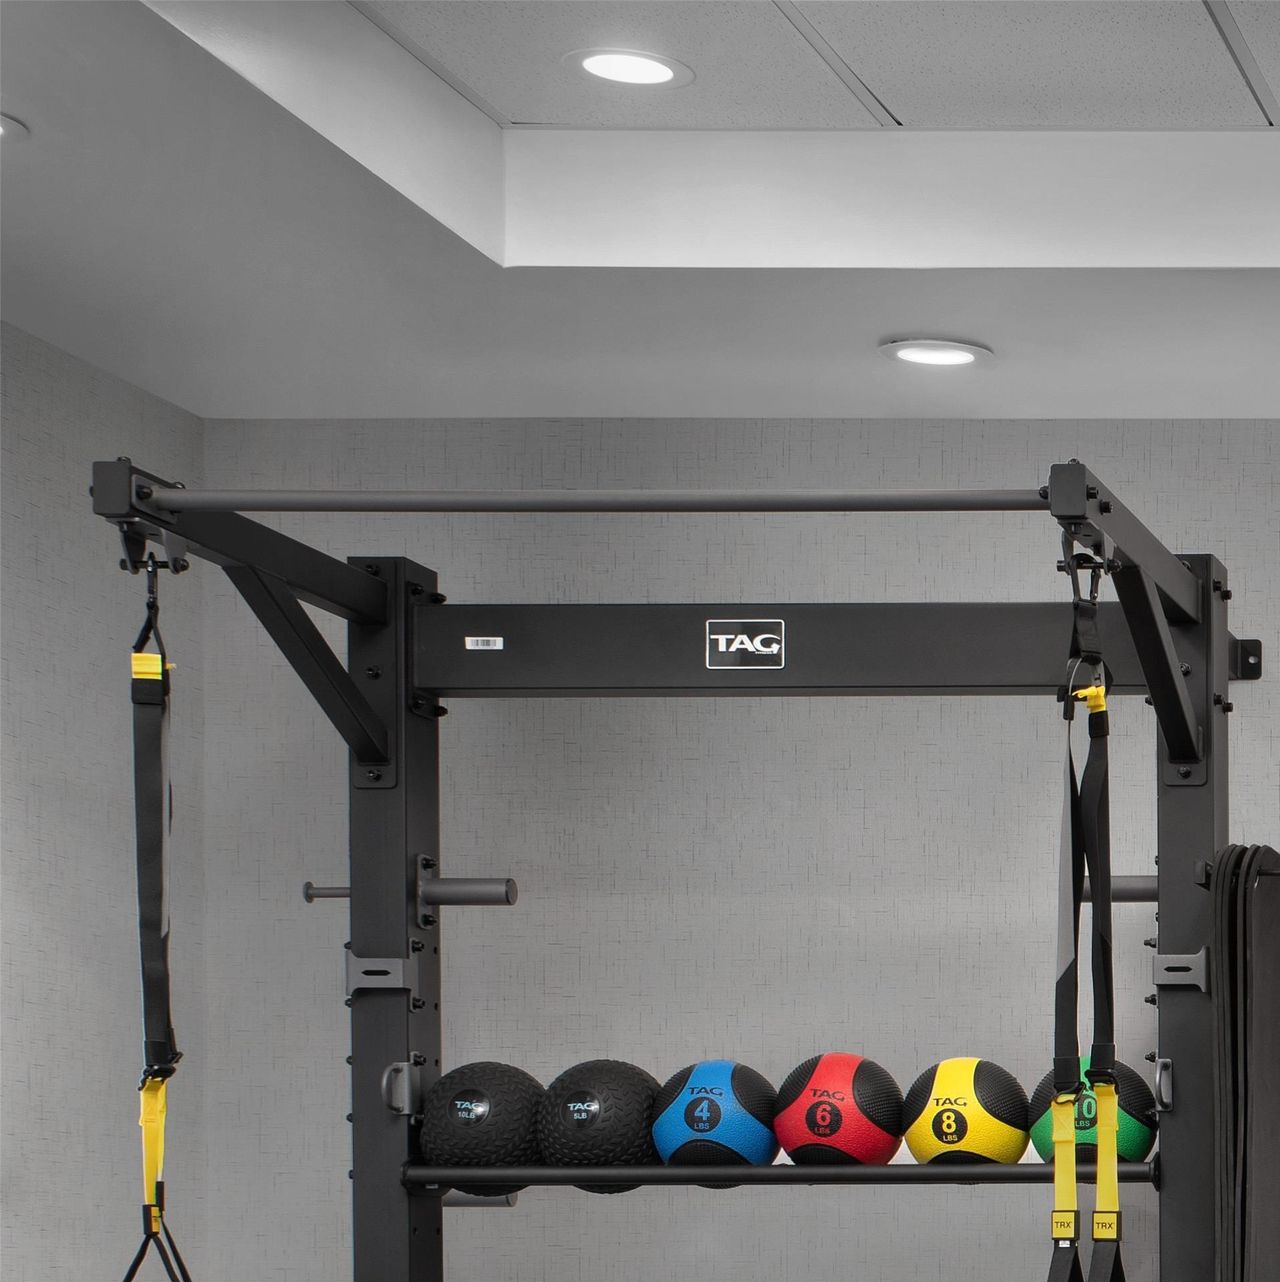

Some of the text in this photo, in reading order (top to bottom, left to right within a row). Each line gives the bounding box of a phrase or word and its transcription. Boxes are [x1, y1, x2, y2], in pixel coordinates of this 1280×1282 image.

[709, 633, 781, 655] TAG
[688, 1086, 724, 1097] TAG
[810, 1088, 846, 1102] TAG
[933, 1096, 968, 1107] TAG
[694, 1099, 711, 1121] 4
[815, 1103, 832, 1126] 6
[941, 1111, 957, 1134] 8
[942, 1134, 958, 1142] LBS
[1054, 1221, 1072, 1229] TRX
[1096, 1222, 1114, 1230] TRX
